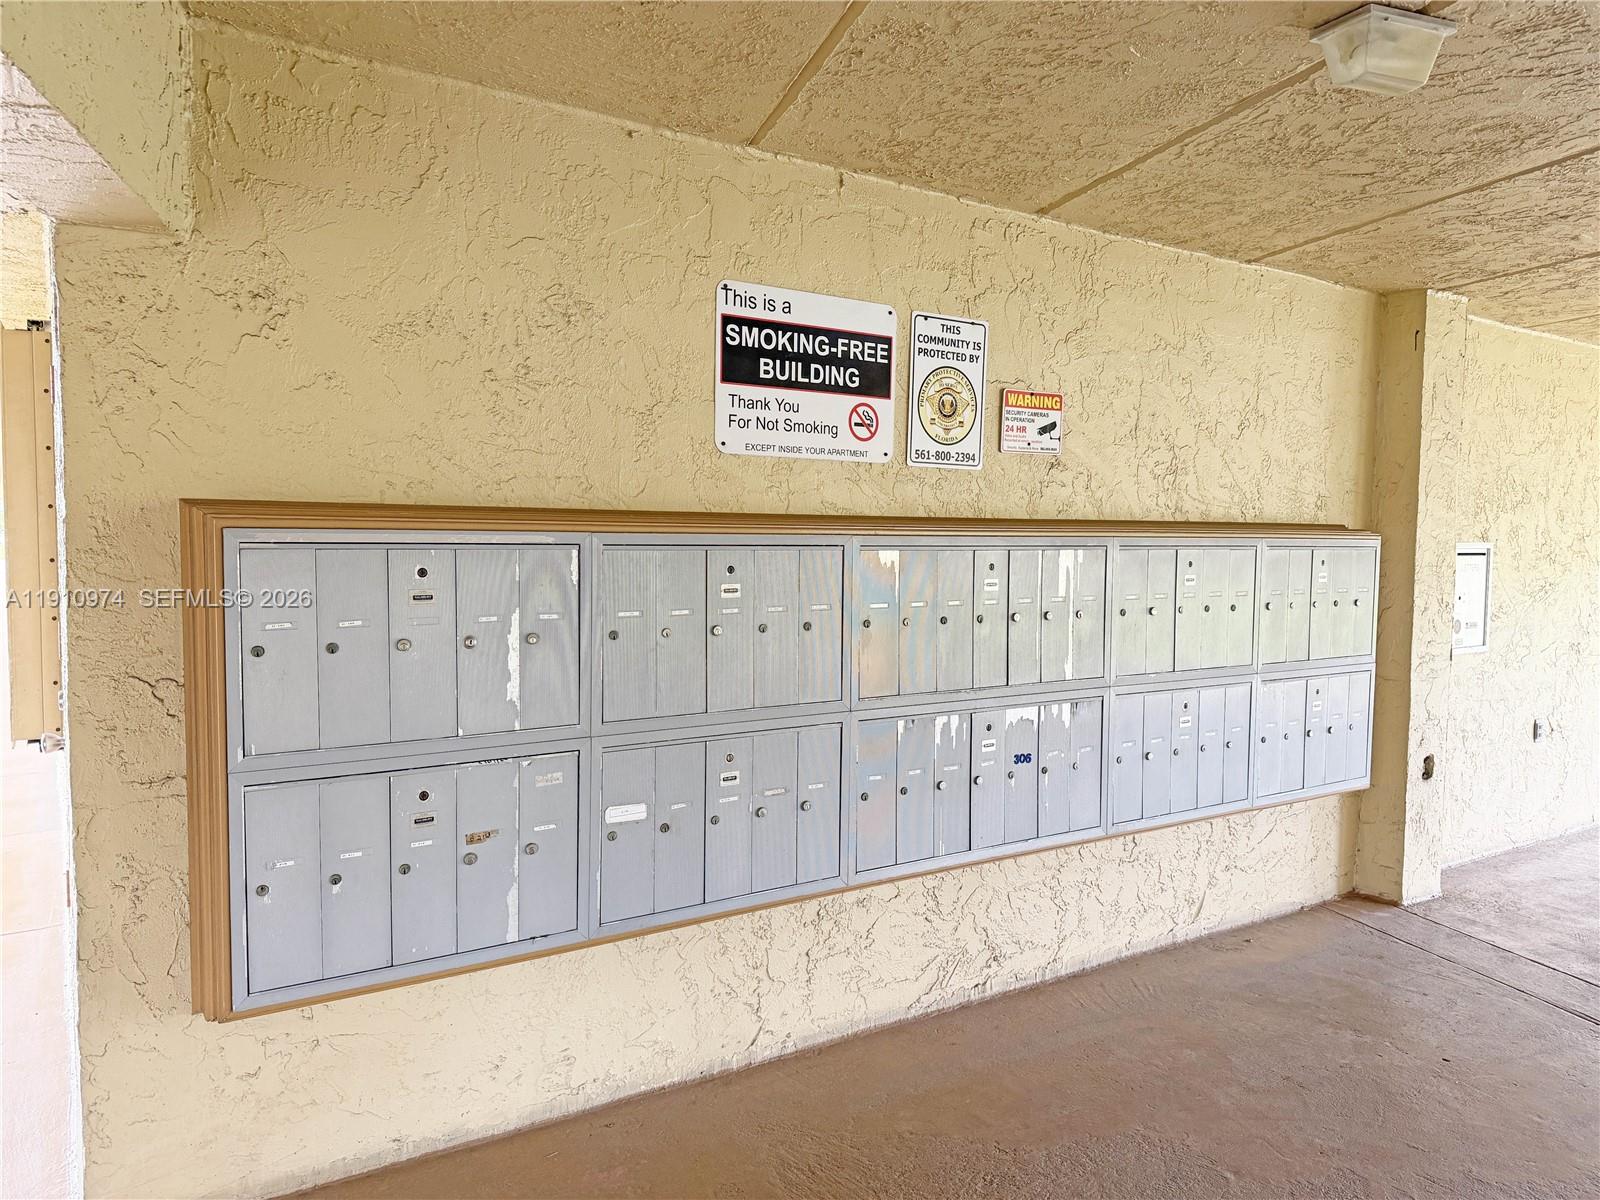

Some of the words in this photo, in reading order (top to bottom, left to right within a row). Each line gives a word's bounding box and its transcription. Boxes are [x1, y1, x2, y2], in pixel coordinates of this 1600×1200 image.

[720, 287, 757, 310] This
[763, 293, 776, 312] is
[781, 301, 792, 315] a
[940, 323, 961, 335] THIS
[725, 323, 889, 364] SMOKING-FREE
[917, 333, 971, 350] COMMUNITY
[972, 341, 982, 351] IS
[917, 347, 967, 362] PROTECTED
[969, 354, 980, 364] BY
[759, 358, 860, 388] BUILDING
[728, 393, 771, 412] Thank
[775, 397, 800, 413] You
[1007, 392, 1061, 410] WARNING
[1005, 409, 1027, 417] SECURITY
[728, 414, 752, 429] For
[755, 416, 780, 432] Not
[783, 418, 839, 439] Smoking
[1005, 424, 1015, 433] 24
[1016, 425, 1027, 433] HR
[935, 433, 959, 443] FLORIDA
[745, 443, 777, 452] EXCEPT
[778, 446, 805, 454] INSIDE
[805, 447, 826, 456] YOUR
[826, 448, 869, 458] APARTMENT
[914, 448, 976, 463] 561-800-2394
[1013, 752, 1033, 766] 306
